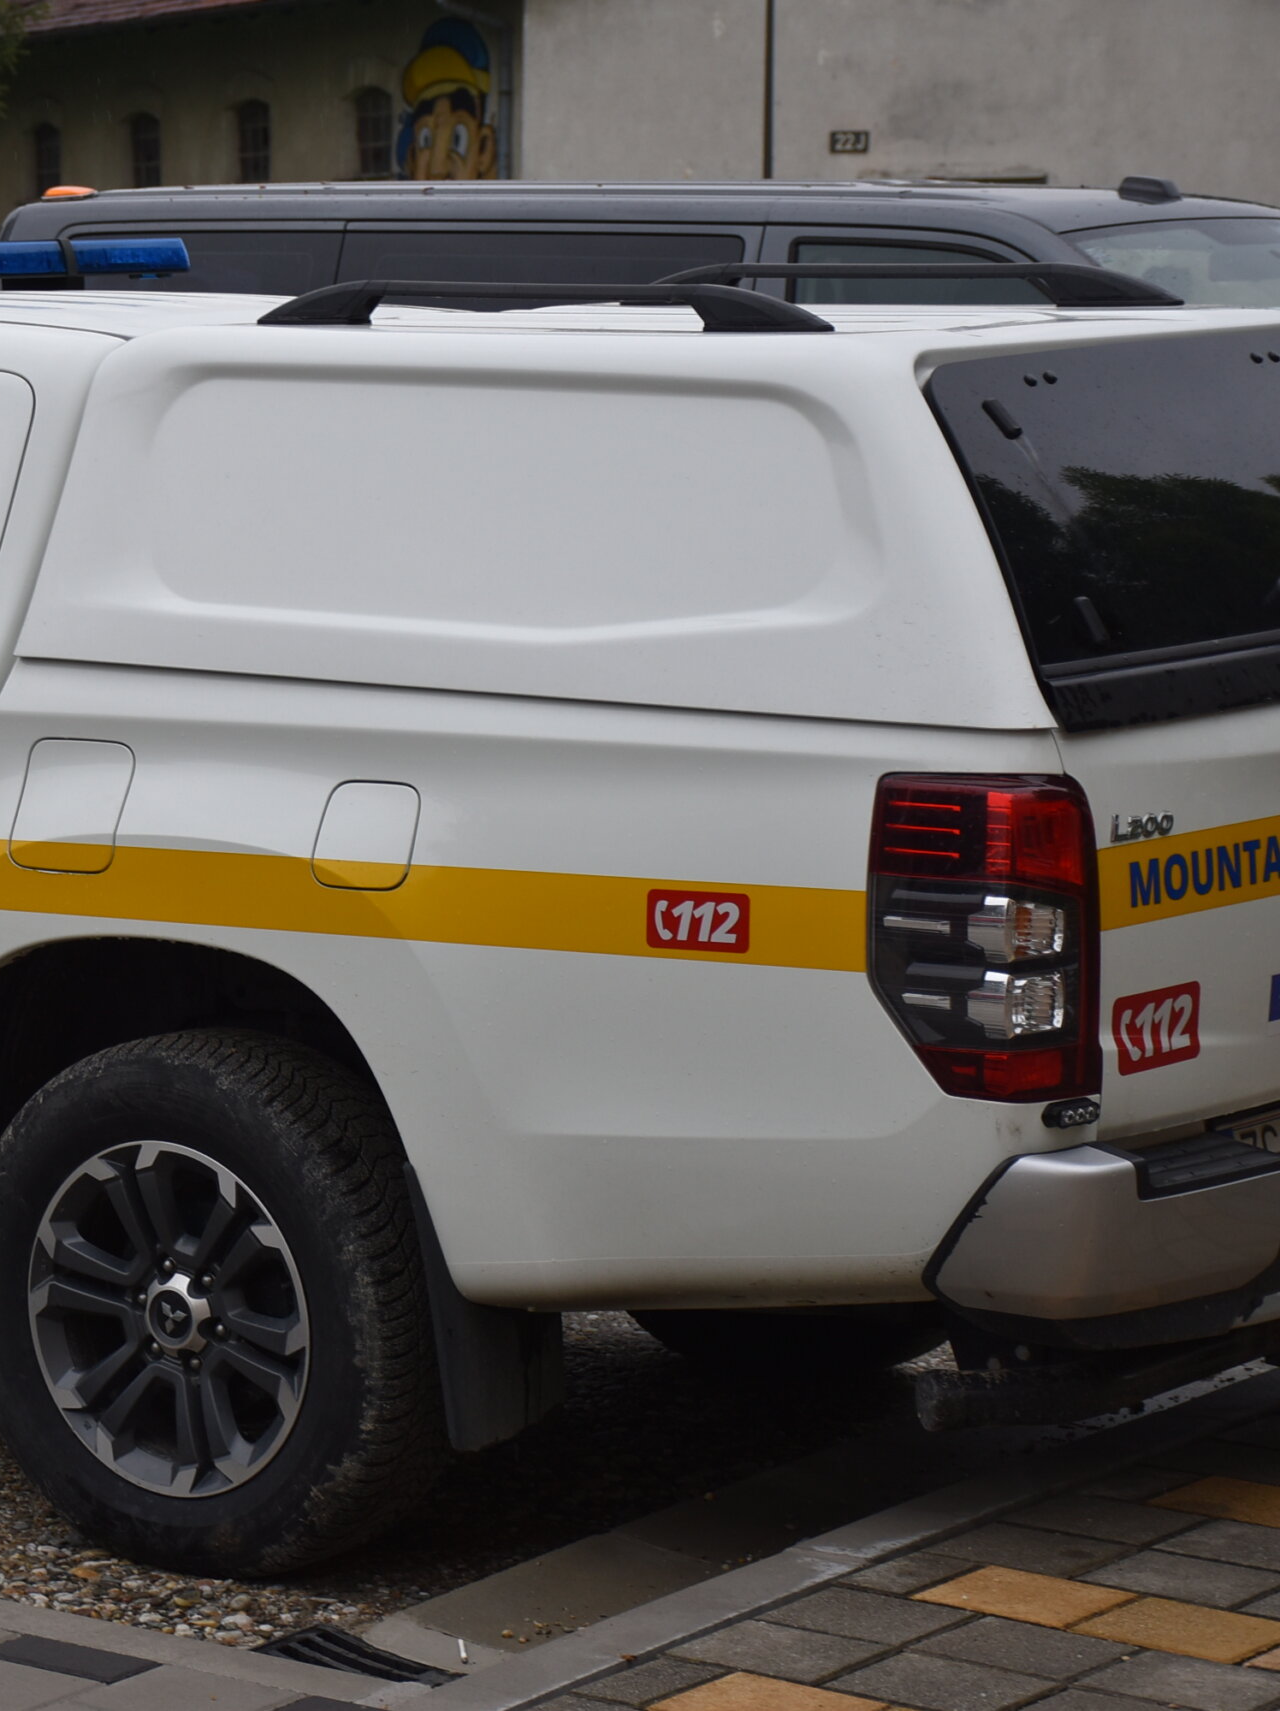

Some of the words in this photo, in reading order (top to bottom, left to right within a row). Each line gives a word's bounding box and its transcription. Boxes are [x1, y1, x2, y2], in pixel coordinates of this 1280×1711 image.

[1110, 810, 1174, 843] L200
[1129, 835, 1280, 908] MOUNTA
[671, 900, 740, 944] 112
[1135, 994, 1193, 1058] 112
